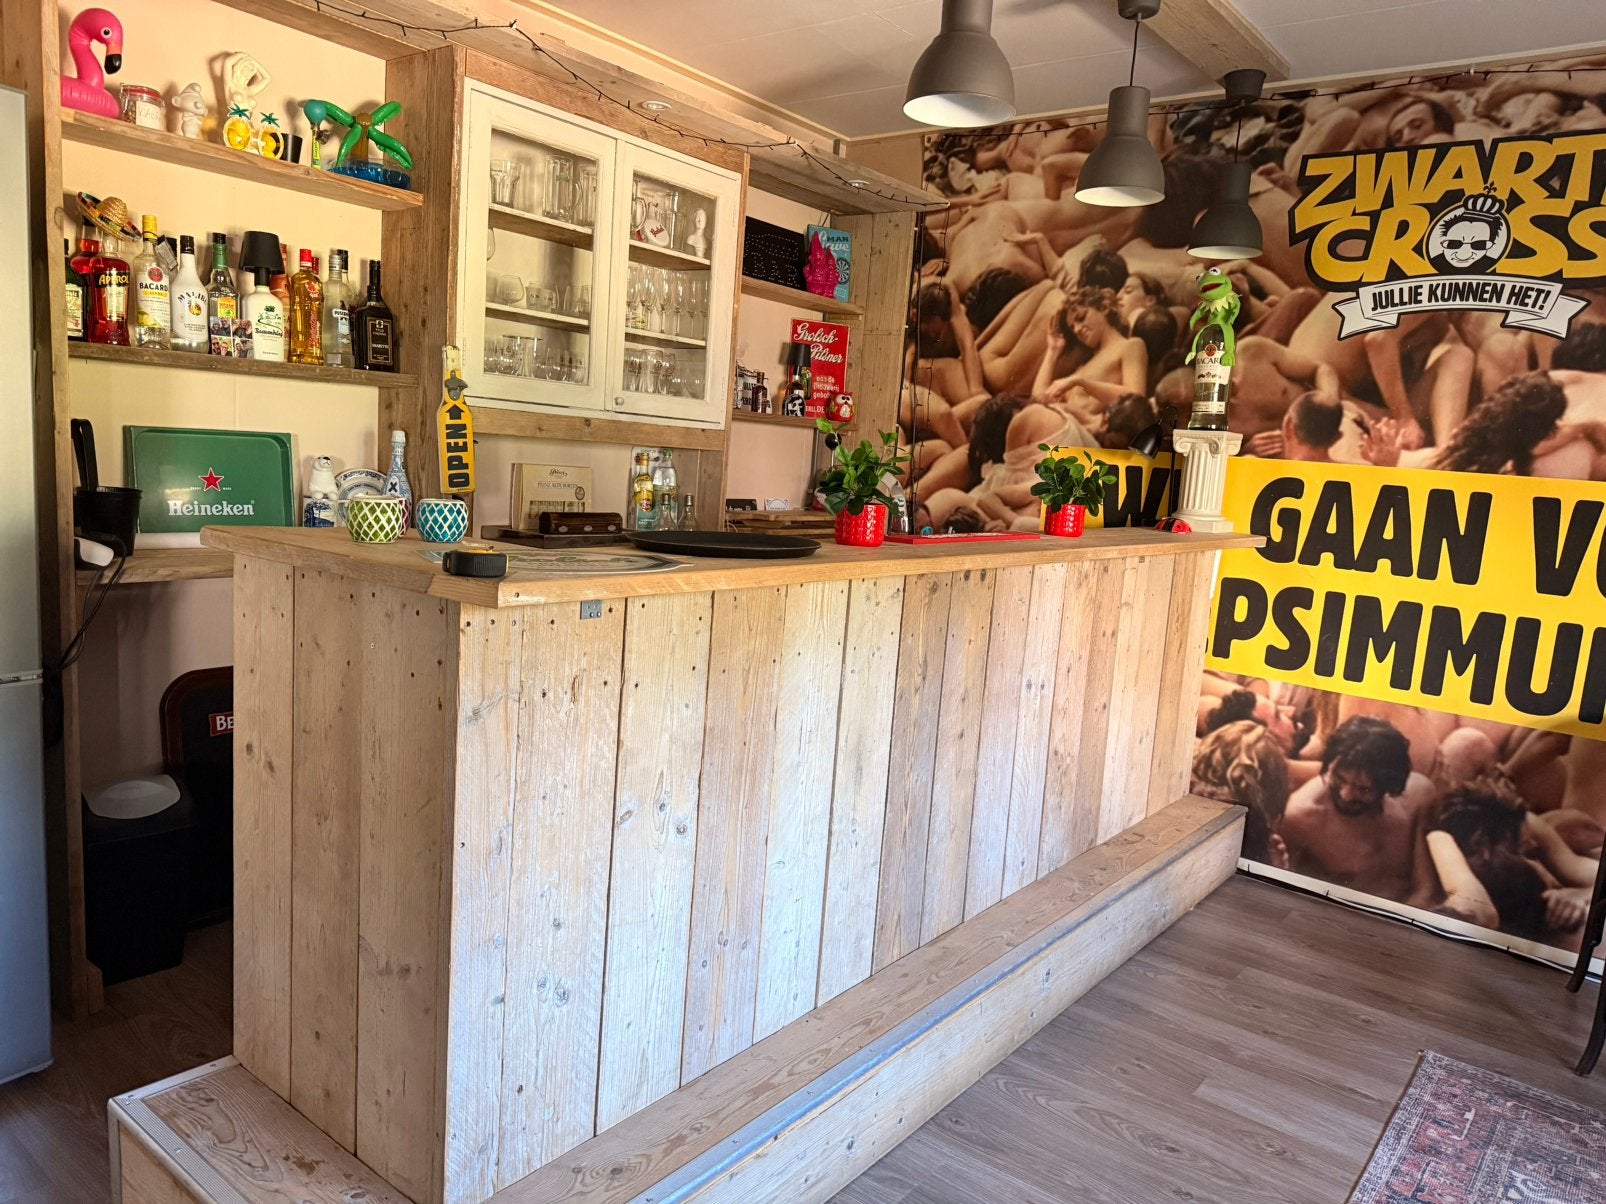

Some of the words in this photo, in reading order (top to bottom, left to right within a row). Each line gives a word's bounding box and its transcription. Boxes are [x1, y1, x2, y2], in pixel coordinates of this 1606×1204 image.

[1295, 133, 1606, 234] ZWART
[139, 282, 168, 292] BACARD
[1371, 284, 1423, 312] JULLIE
[1427, 281, 1504, 305] KUNNEN
[1506, 284, 1552, 310] HET!
[445, 423, 470, 489] OPEN
[167, 500, 254, 516] Heineken
[1249, 476, 1492, 586] GAAN
[1207, 577, 1606, 724] PSIMMU
